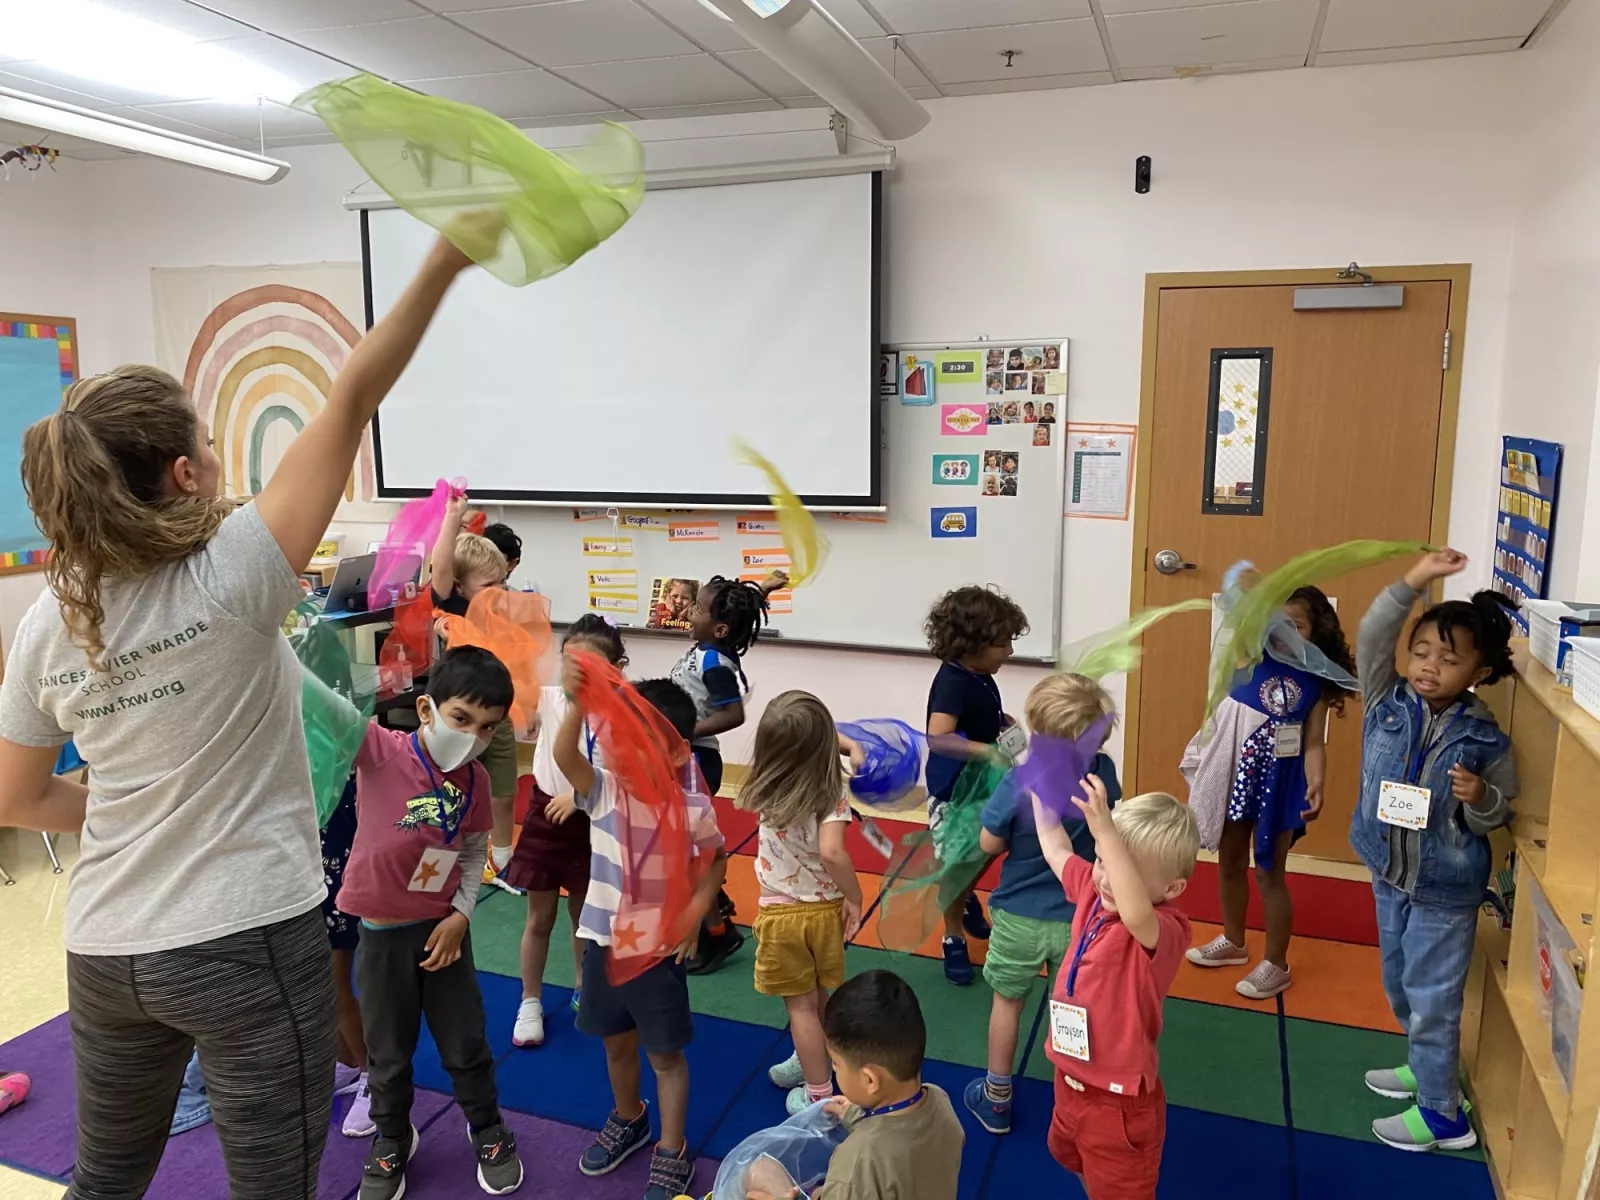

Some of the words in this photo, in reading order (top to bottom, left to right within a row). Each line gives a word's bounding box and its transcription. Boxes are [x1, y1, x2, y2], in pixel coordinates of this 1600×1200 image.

[660, 618, 692, 630] Feeling
[146, 621, 209, 655] WARDE
[81, 667, 146, 697] SCHOOL
[75, 680, 185, 720] www.fxw.org
[1389, 796, 1413, 810] Zoe
[1055, 1017, 1086, 1042] Grayson
